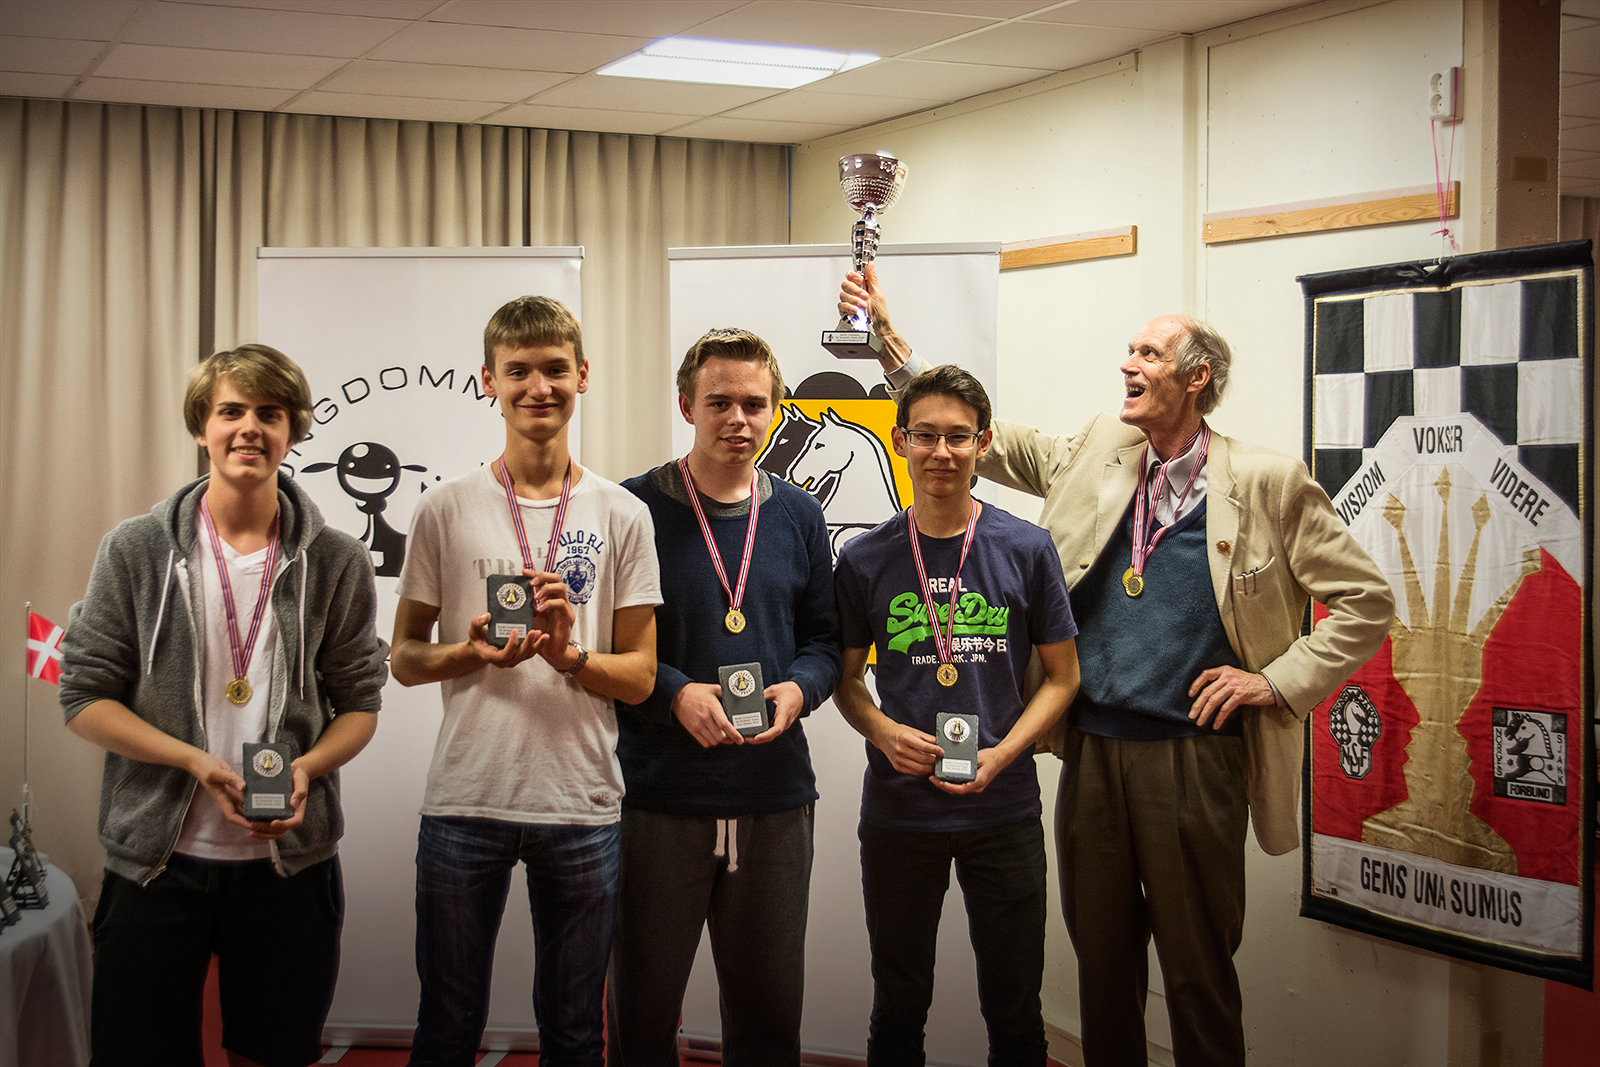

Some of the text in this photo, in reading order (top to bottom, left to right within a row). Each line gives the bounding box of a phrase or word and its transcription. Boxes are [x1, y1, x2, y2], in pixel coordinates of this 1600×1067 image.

[1413, 425, 1463, 454] VOKSER
[1335, 461, 1386, 527] VISDOM
[1489, 457, 1550, 527] VIDERE
[547, 530, 584, 547] OLO
[566, 546, 590, 555] 1967
[928, 576, 968, 594] REAL
[1509, 783, 1551, 800] FORBUND
[1360, 857, 1523, 927] GENS UNA SUMUS
